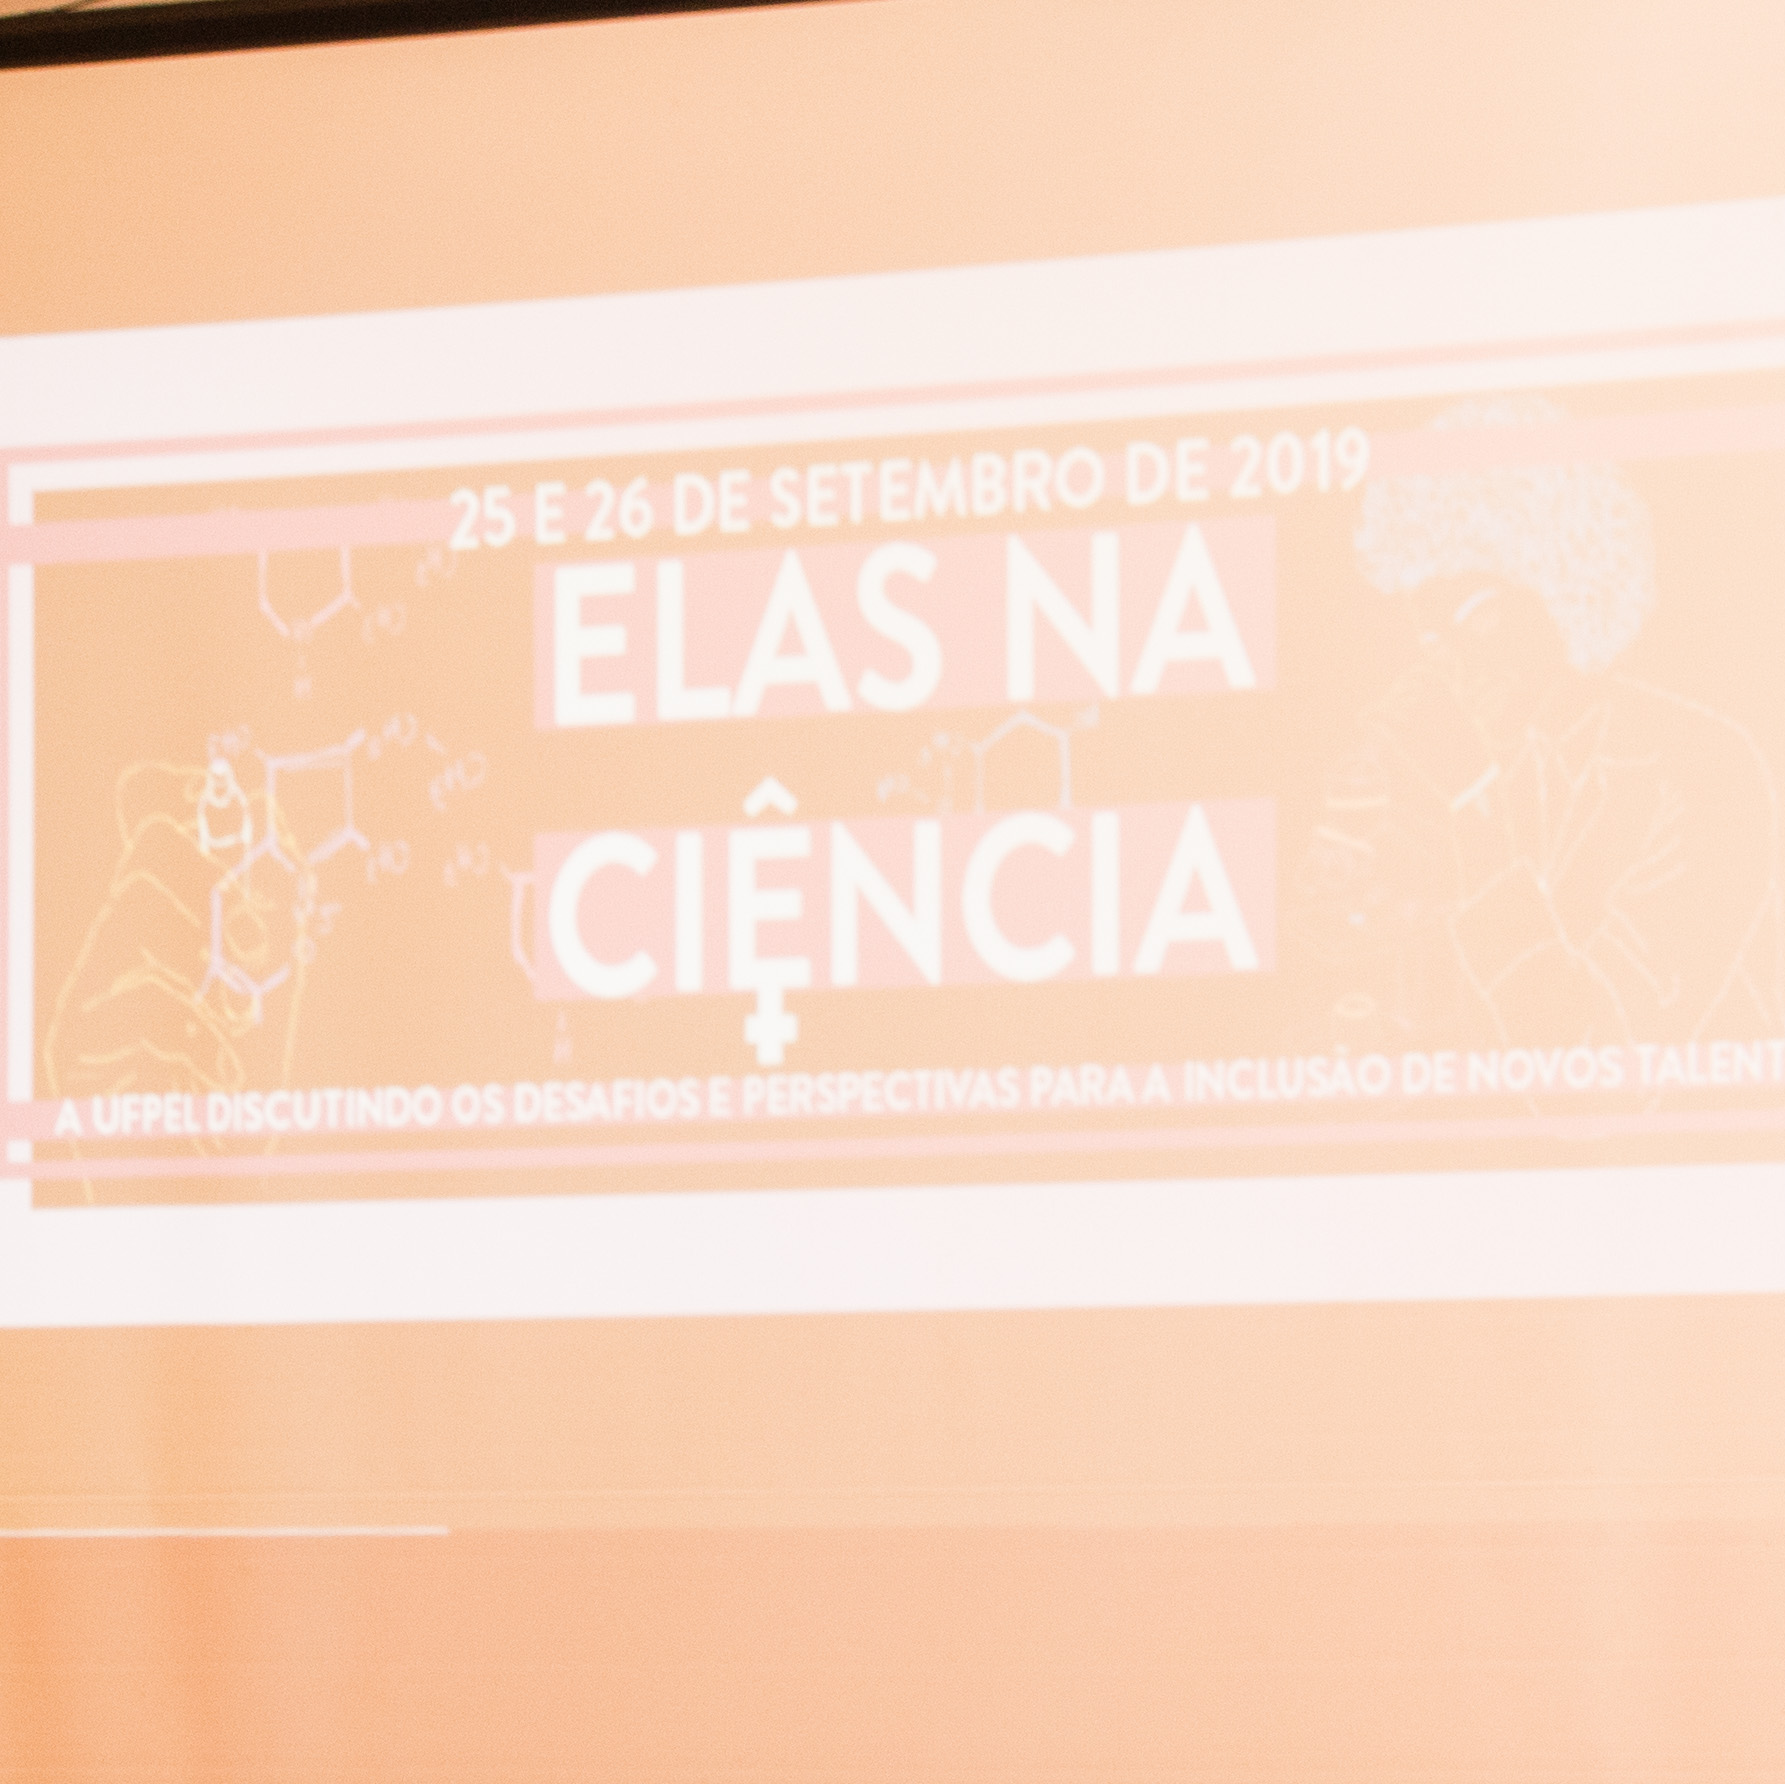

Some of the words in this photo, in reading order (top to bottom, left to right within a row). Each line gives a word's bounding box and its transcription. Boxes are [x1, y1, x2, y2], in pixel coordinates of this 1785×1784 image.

[450, 486, 516, 551] 25
[535, 481, 566, 545] E
[586, 477, 653, 542] 26
[674, 470, 750, 536] DE
[771, 444, 1104, 529] SETEMBRO
[1127, 438, 1209, 506] DE
[1229, 426, 1370, 500] 2019
[553, 540, 942, 727] ELAS
[1006, 521, 1258, 701] NA
[547, 775, 1260, 1003] CIÊNCIA
[54, 1098, 83, 1135] A
[92, 1092, 201, 1136] UFPEL
[208, 1086, 442, 1133] DISCUTINDO
[451, 1082, 508, 1126] OS
[513, 1076, 700, 1124] DESAFIOS
[708, 1075, 732, 1119] E
[742, 1066, 1022, 1118] PERSPECTIVAS
[1030, 1063, 1132, 1106] PARA
[1140, 1061, 1173, 1104] A
[1183, 1041, 1394, 1101] INCLUSÃO
[1404, 1050, 1457, 1094] DE
[1466, 1043, 1625, 1092] NOVOS
